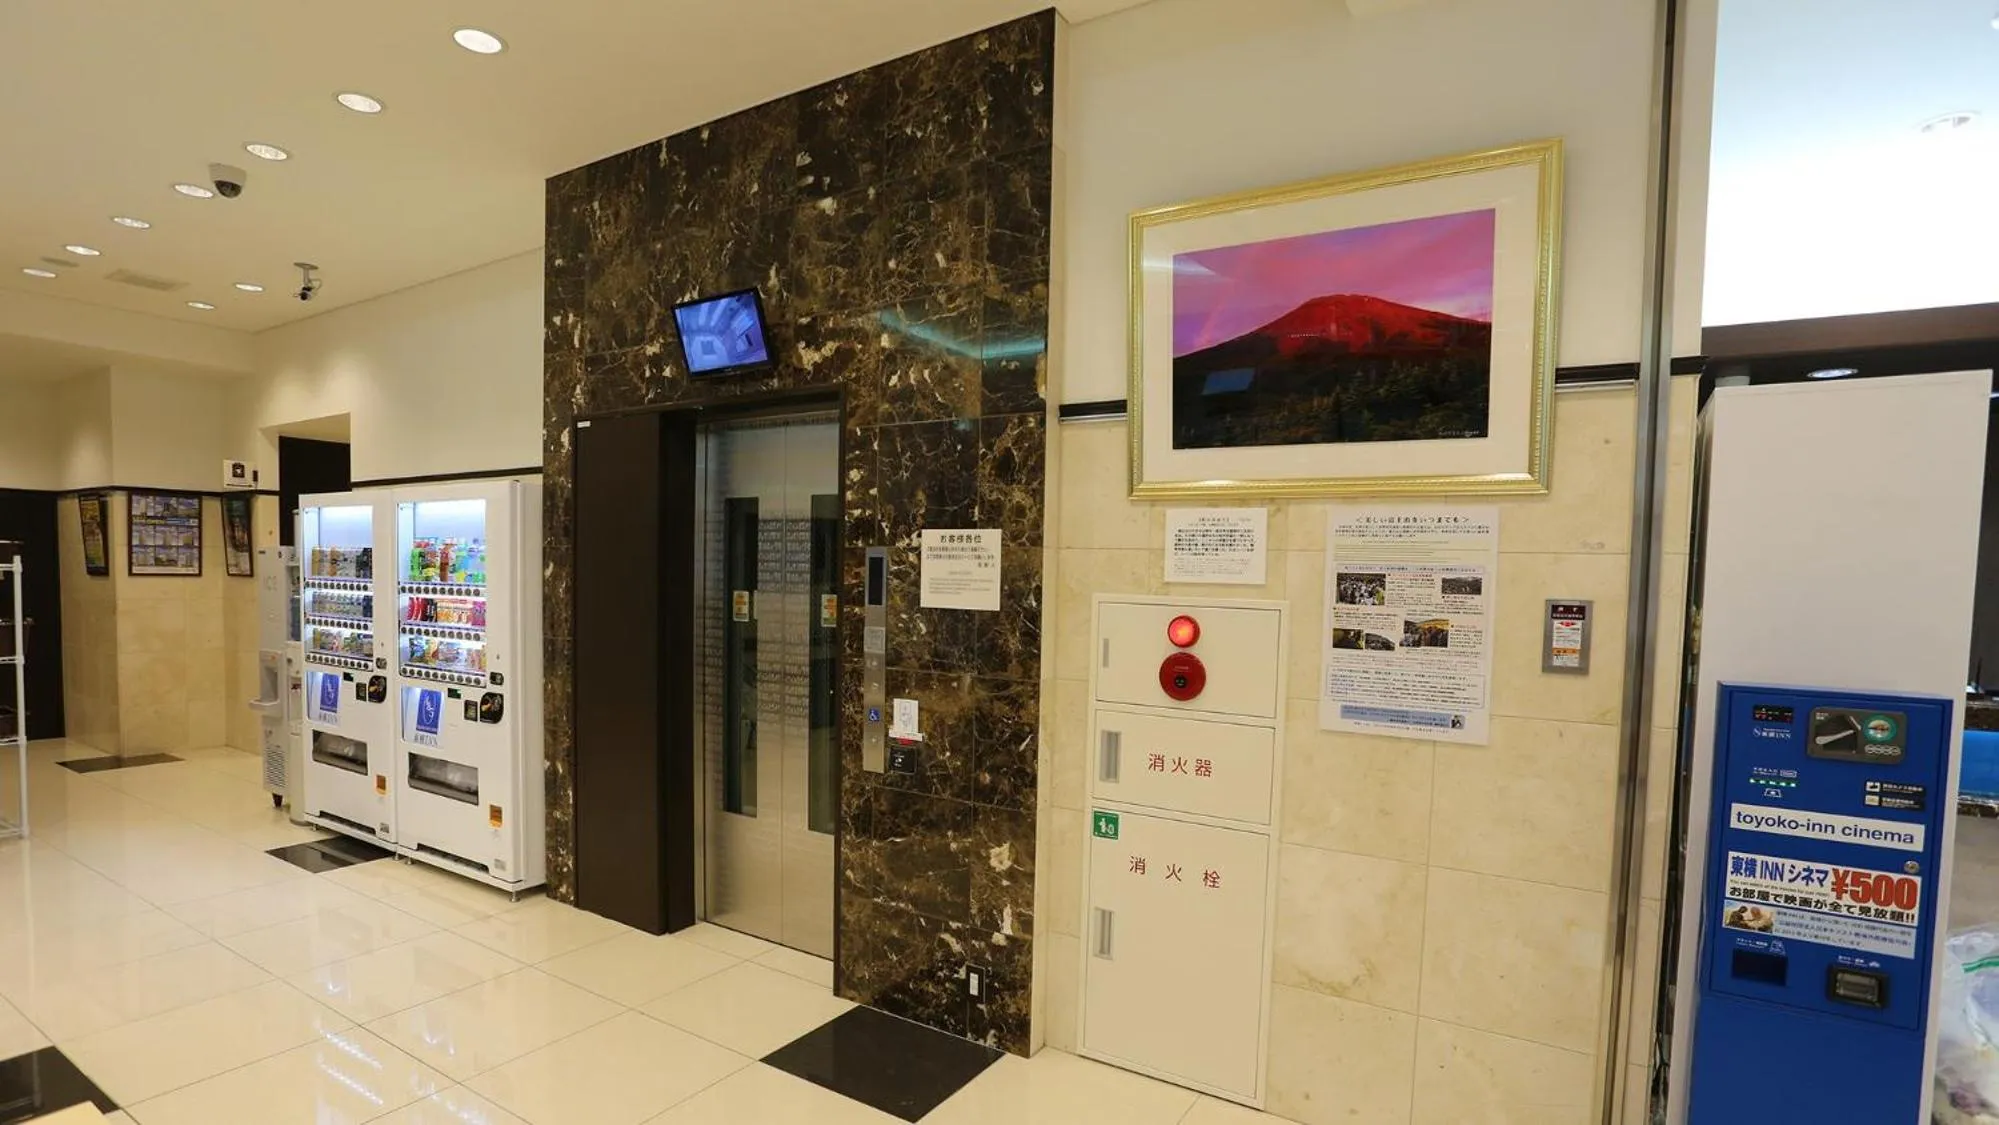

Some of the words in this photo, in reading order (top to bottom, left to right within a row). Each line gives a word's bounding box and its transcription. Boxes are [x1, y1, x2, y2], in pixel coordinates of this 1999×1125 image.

[940, 533, 982, 544] お客様各位
[1148, 753, 1212, 778] 消火器
[1736, 811, 1836, 834] toyoko-inn
[1841, 824, 1914, 844] cinema
[1129, 855, 1221, 888] 消火栓
[1730, 855, 1757, 880] 東横
[1760, 860, 1785, 883] INN
[1787, 864, 1830, 889] シネマ
[1831, 867, 1919, 911] ¥500
